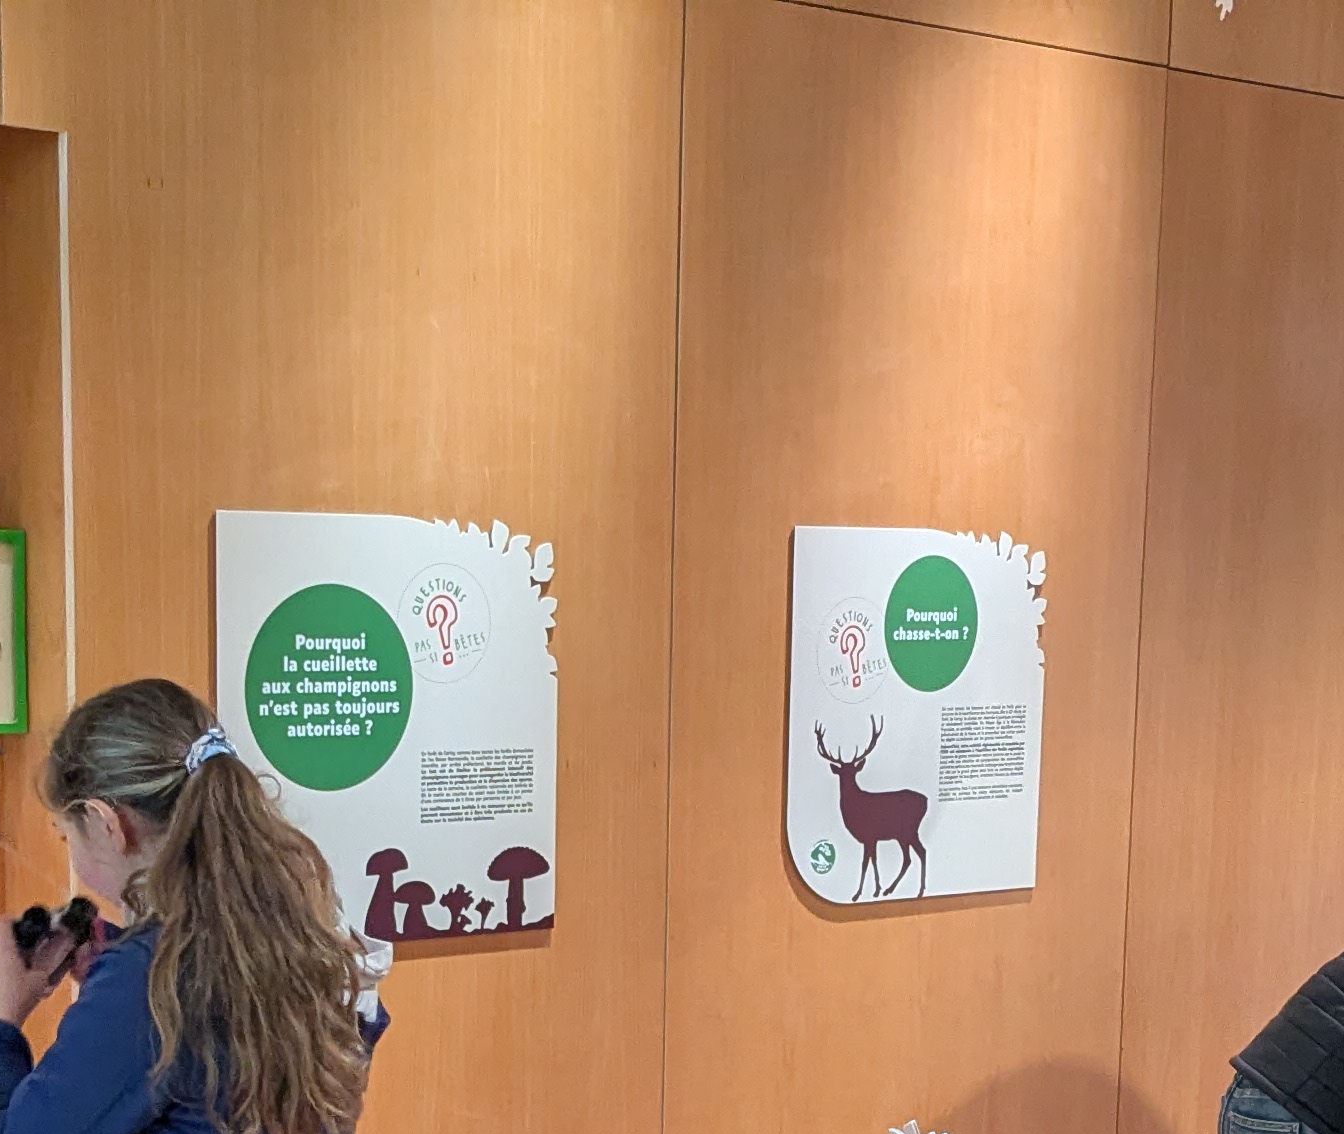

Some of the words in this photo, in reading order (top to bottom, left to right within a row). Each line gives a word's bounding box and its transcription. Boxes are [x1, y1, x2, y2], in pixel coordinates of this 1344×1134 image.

[412, 578, 467, 615] QUESTIONS
[906, 607, 958, 625] Pourquoi
[829, 610, 873, 644] QUESTIONS
[893, 626, 959, 641] chasse-t-on
[962, 626, 969, 640] ?
[295, 632, 366, 653] Pourquoi
[415, 639, 431, 653] PAS
[454, 632, 485, 651] BÊTES
[283, 655, 298, 672] la
[303, 654, 378, 672] cueillette
[429, 652, 438, 663] SI
[862, 658, 887, 674] BÊTES
[830, 664, 844, 677] PAS
[262, 681, 291, 694] aux
[296, 675, 397, 697] champignons
[259, 699, 298, 716] n'est
[303, 702, 330, 719] pas
[335, 697, 400, 718] toujours
[287, 718, 360, 737] autorisée
[365, 719, 373, 735] ?
